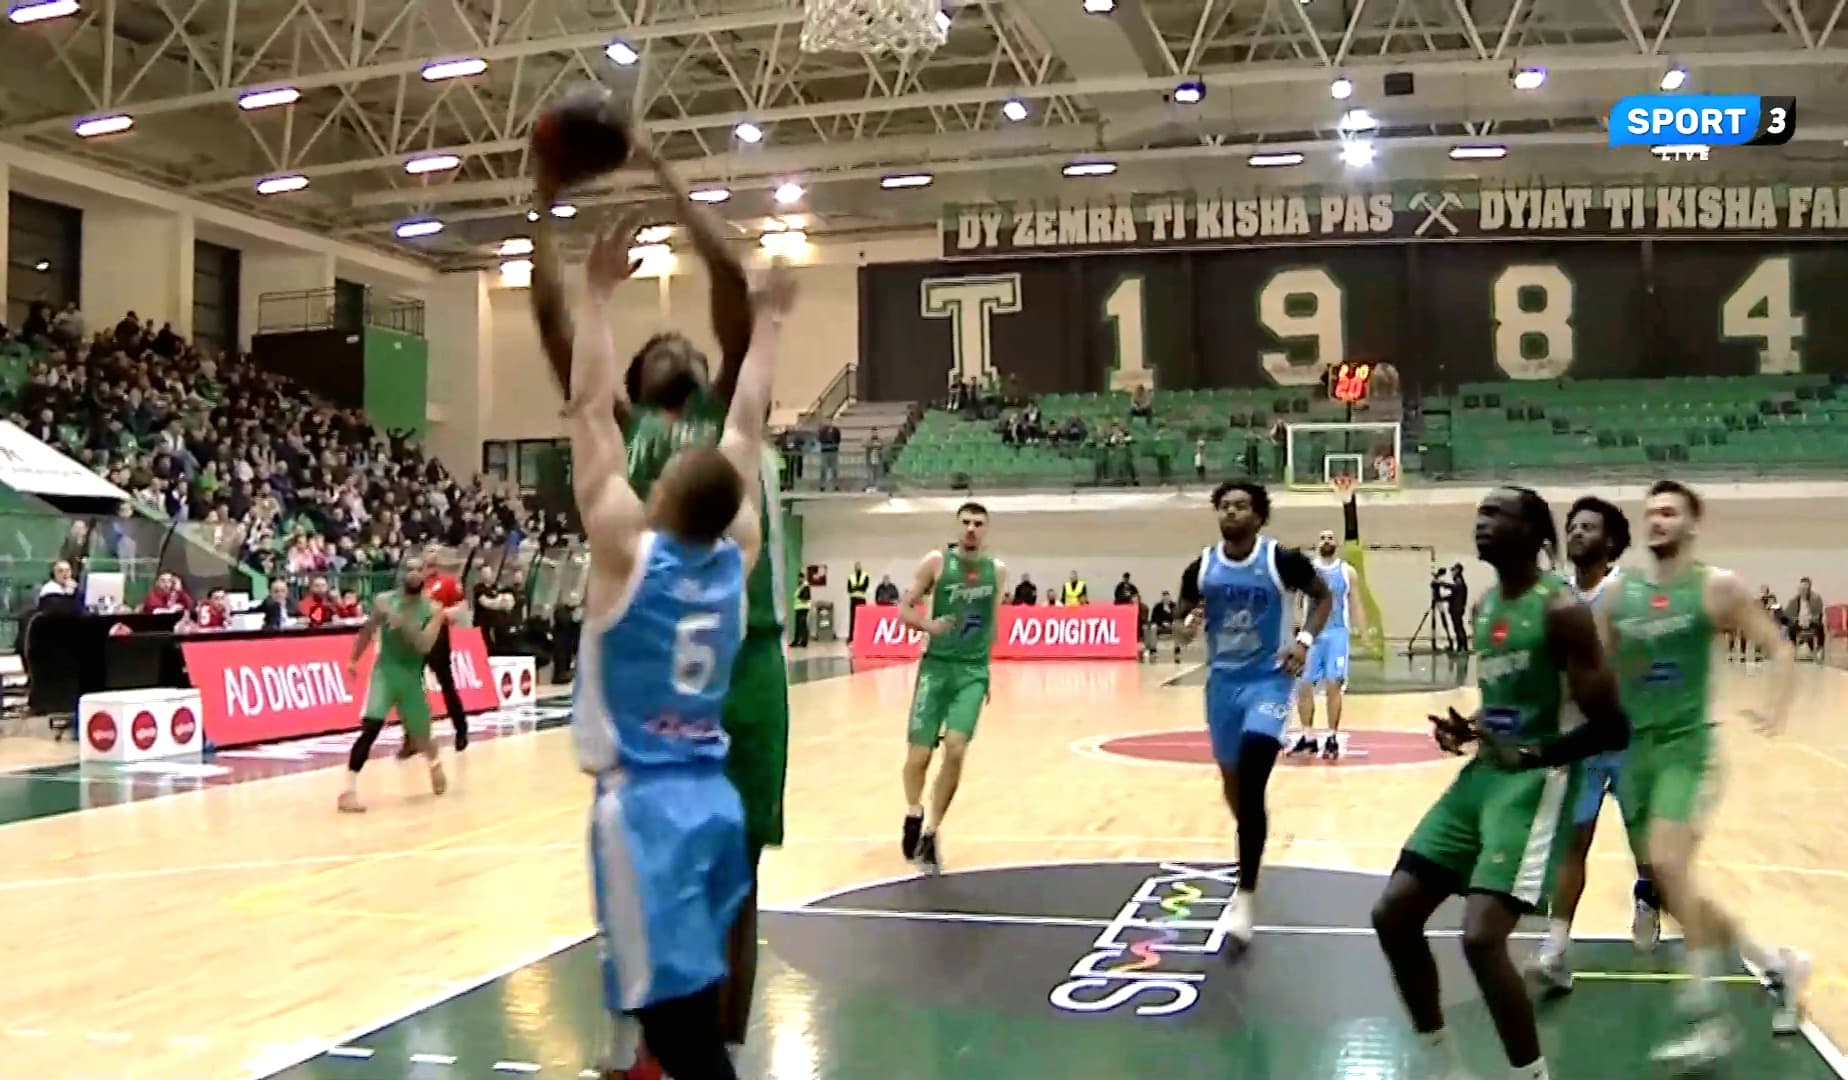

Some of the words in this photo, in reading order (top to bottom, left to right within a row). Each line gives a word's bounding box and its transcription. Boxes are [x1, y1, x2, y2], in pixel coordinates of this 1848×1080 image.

[957, 212, 1002, 250] DY
[1012, 207, 1137, 247] ZEMRA
[1146, 201, 1186, 240] TI
[1196, 197, 1310, 239] KISHA
[1321, 194, 1394, 234] PAS
[1480, 187, 1592, 230] DYJAT
[1603, 187, 1646, 229] TI
[1655, 186, 1777, 229] KISHA
[1045, 617, 1120, 644] DIGITAL
[261, 661, 353, 712] DIGITAL
